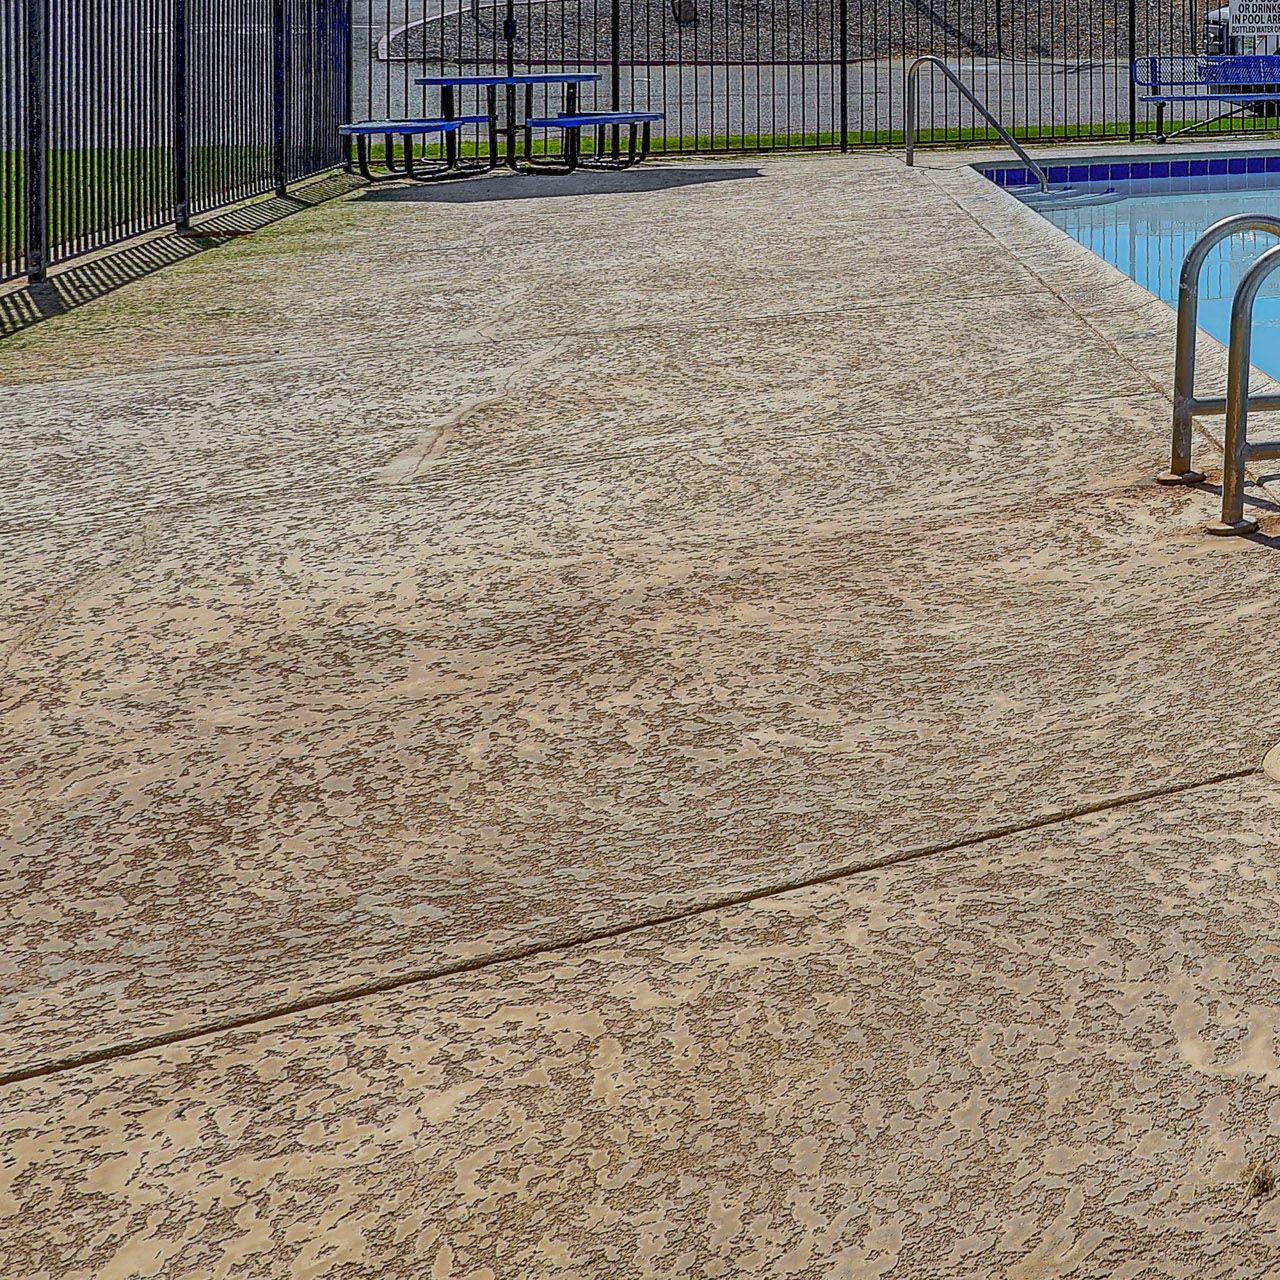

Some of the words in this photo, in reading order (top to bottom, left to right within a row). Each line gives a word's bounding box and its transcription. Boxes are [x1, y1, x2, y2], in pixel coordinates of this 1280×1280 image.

[1238, 3, 1251, 14] OR
[1231, 14, 1240, 25] IN
[1242, 14, 1265, 25] POOL
[1231, 25, 1256, 34] BOTTLED
[1256, 25, 1273, 34] WATER
